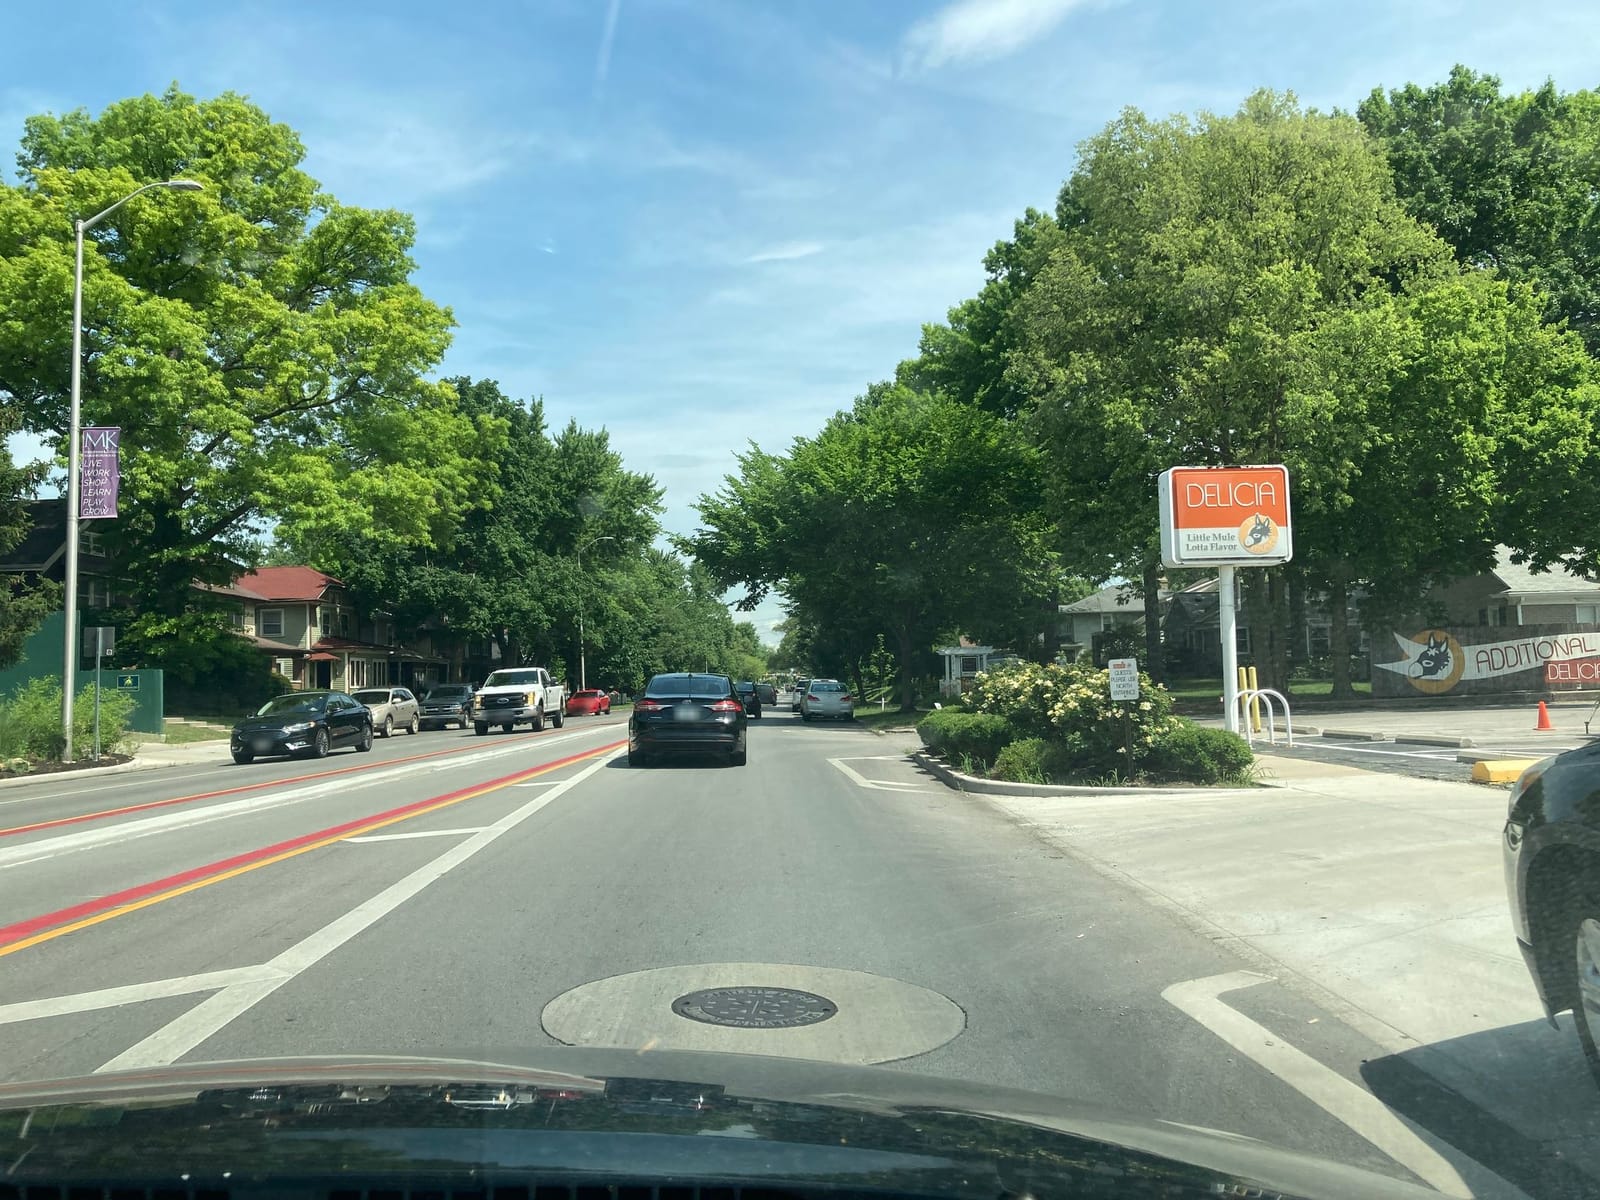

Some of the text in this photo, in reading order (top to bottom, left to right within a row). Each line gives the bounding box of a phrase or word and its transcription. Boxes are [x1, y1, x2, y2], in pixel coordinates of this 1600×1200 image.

[85, 431, 118, 449] MK
[83, 459, 103, 468] LIVE
[84, 469, 111, 477] WORK
[83, 478, 108, 487] SHOP
[83, 488, 112, 497] LEARN
[1186, 482, 1276, 508] DELICIA
[83, 498, 104, 507] PLAY
[82, 507, 109, 516] GROW
[1187, 532, 1236, 542] Little Mule
[1186, 542, 1238, 552] Lotta Flavor
[1475, 637, 1597, 673] ADDITIONAL
[1548, 663, 1600, 680] DELICI
